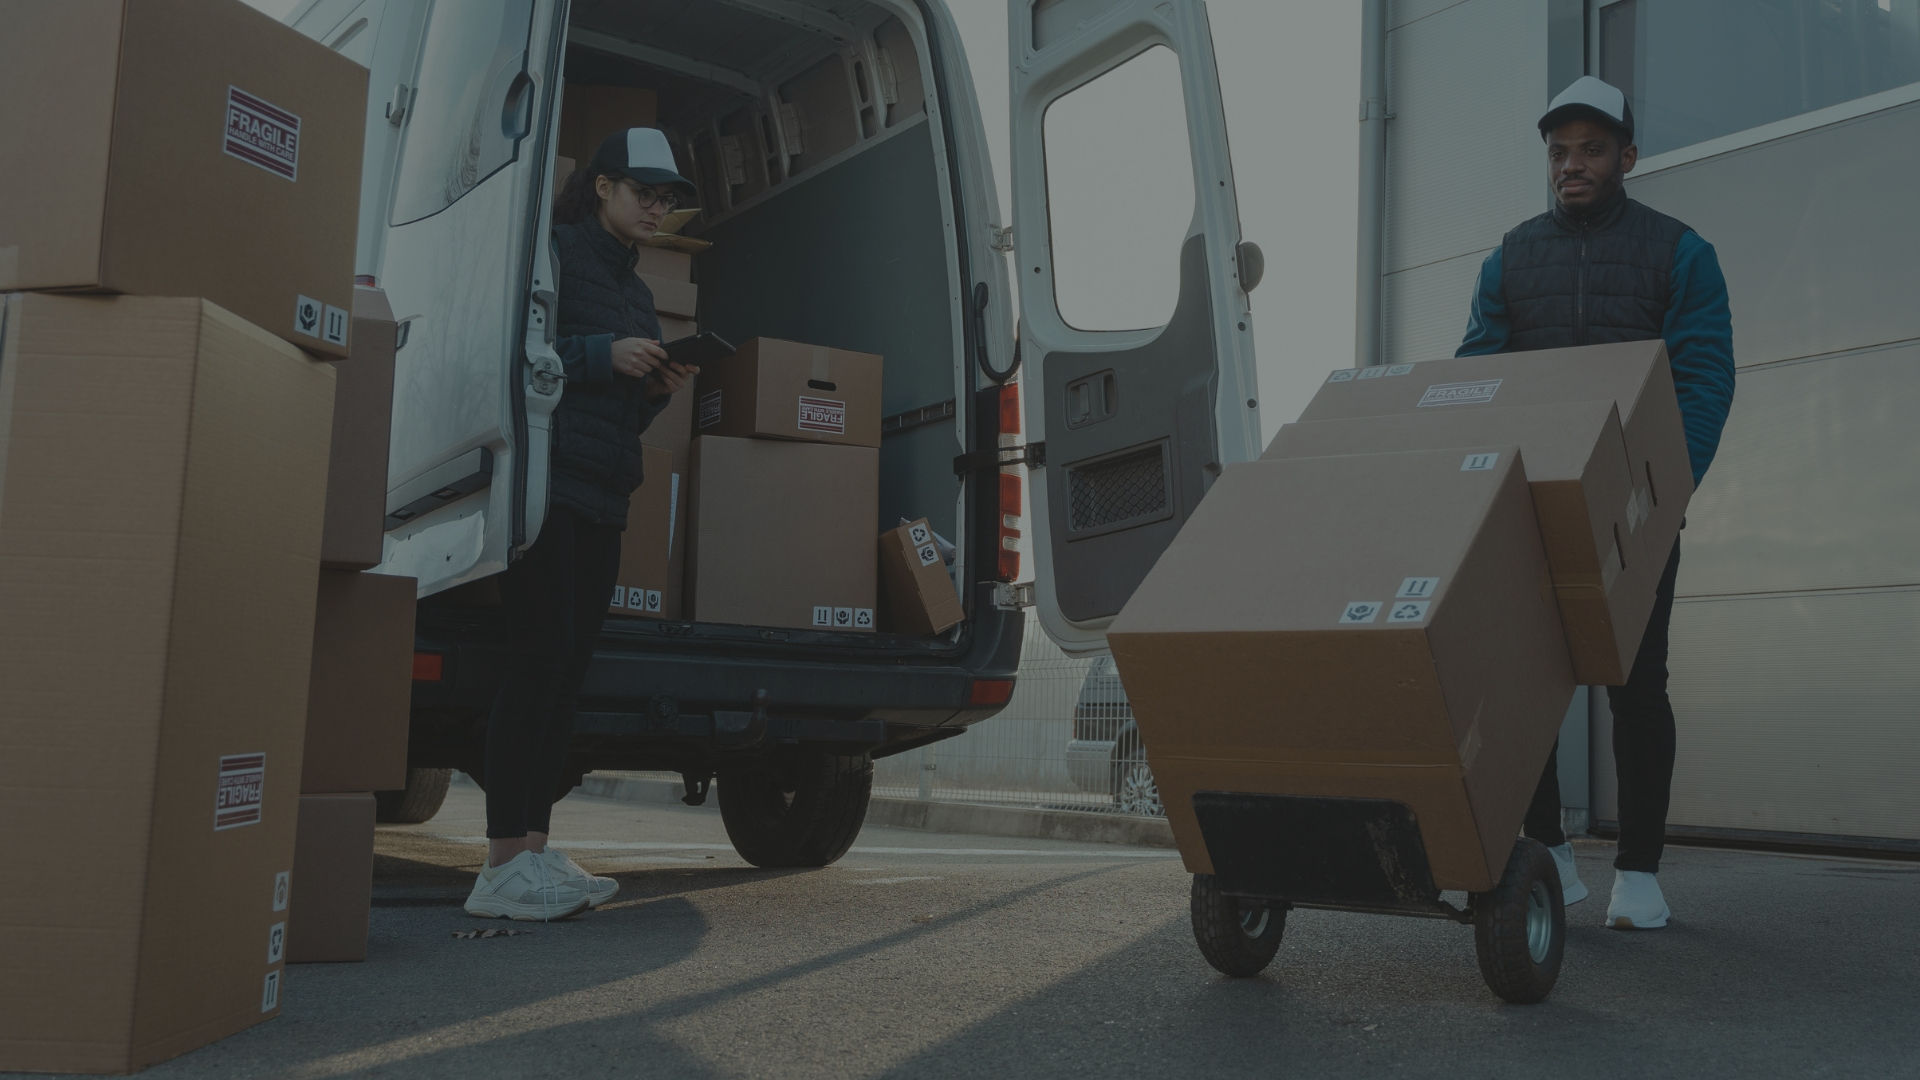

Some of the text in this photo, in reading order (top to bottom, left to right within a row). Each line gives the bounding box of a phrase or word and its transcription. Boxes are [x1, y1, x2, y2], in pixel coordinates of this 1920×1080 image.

[229, 108, 296, 153] FRAGILE
[229, 126, 294, 161] HANDLE WITH CARE
[1426, 386, 1495, 398] FRAGILE
[801, 410, 843, 424] FRAGILE
[221, 777, 234, 786] CARE
[234, 776, 245, 785] WITH
[219, 783, 262, 806] FRAGILE
